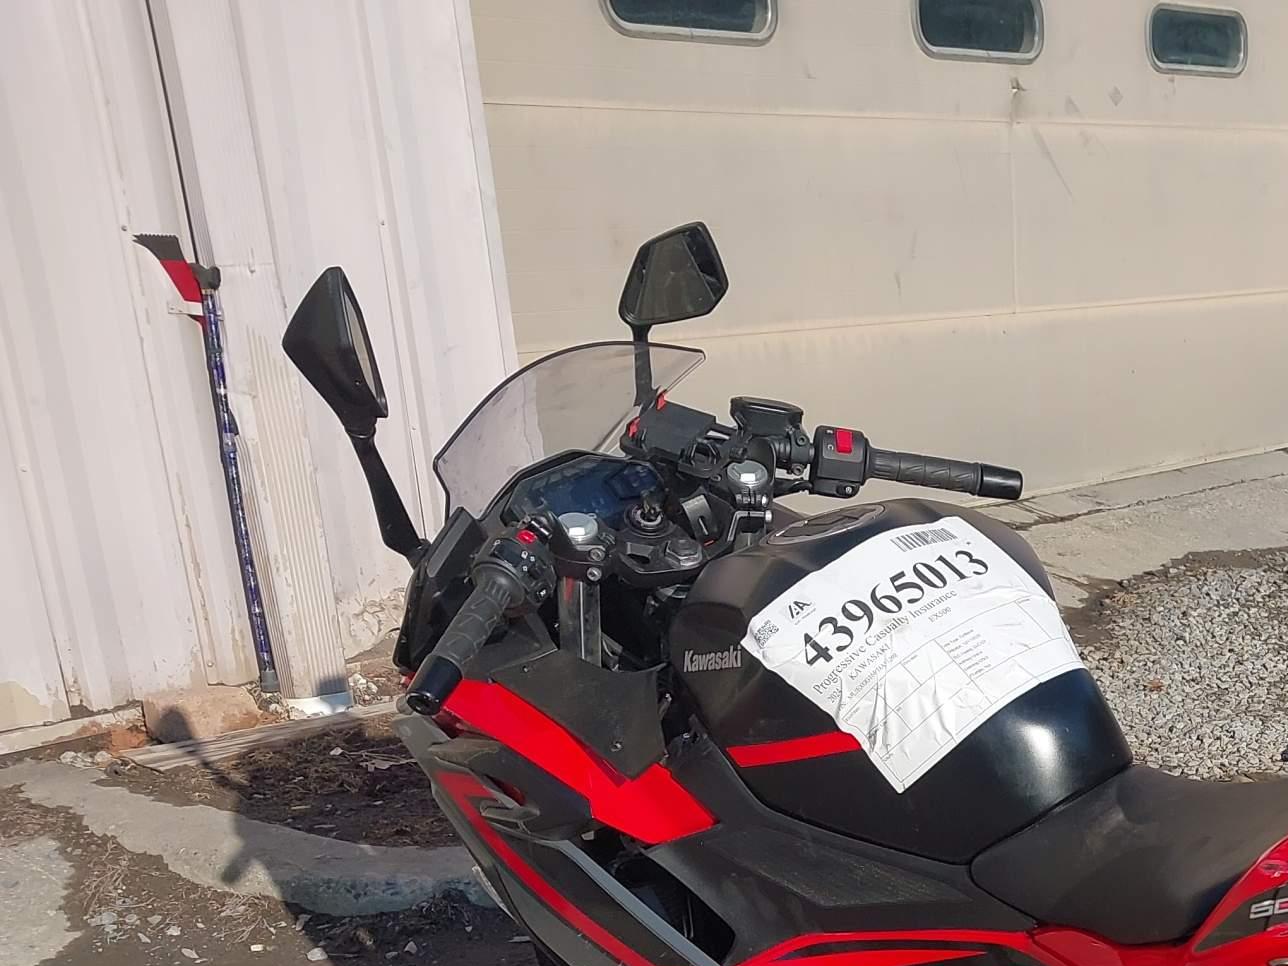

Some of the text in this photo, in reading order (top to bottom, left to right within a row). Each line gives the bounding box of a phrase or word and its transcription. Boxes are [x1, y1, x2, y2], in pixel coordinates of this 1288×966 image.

[804, 550, 989, 666] 43965013
[812, 645, 866, 695] Progressive
[865, 614, 910, 646] Casualty
[908, 589, 958, 619] Insurance
[683, 644, 742, 673] Kawasaki
[848, 643, 891, 680] KAWASAKI
